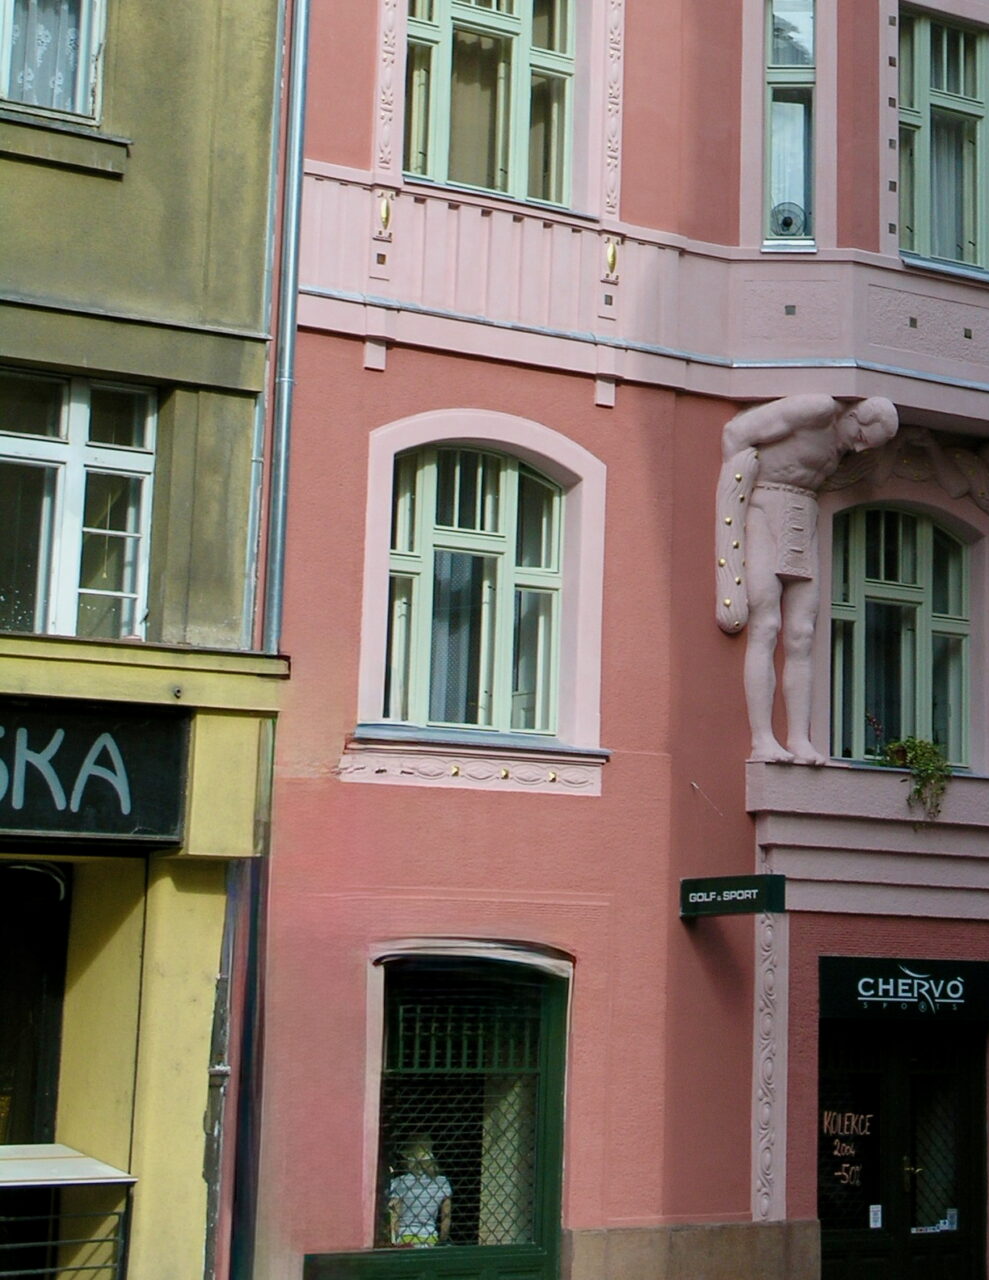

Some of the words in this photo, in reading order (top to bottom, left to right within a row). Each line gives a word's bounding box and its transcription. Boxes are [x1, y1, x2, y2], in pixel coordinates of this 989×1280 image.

[0, 725, 131, 815] KA
[689, 892, 716, 902] GOLF
[723, 889, 758, 901] SPORT
[823, 1111, 873, 1136] KOLEKCE
